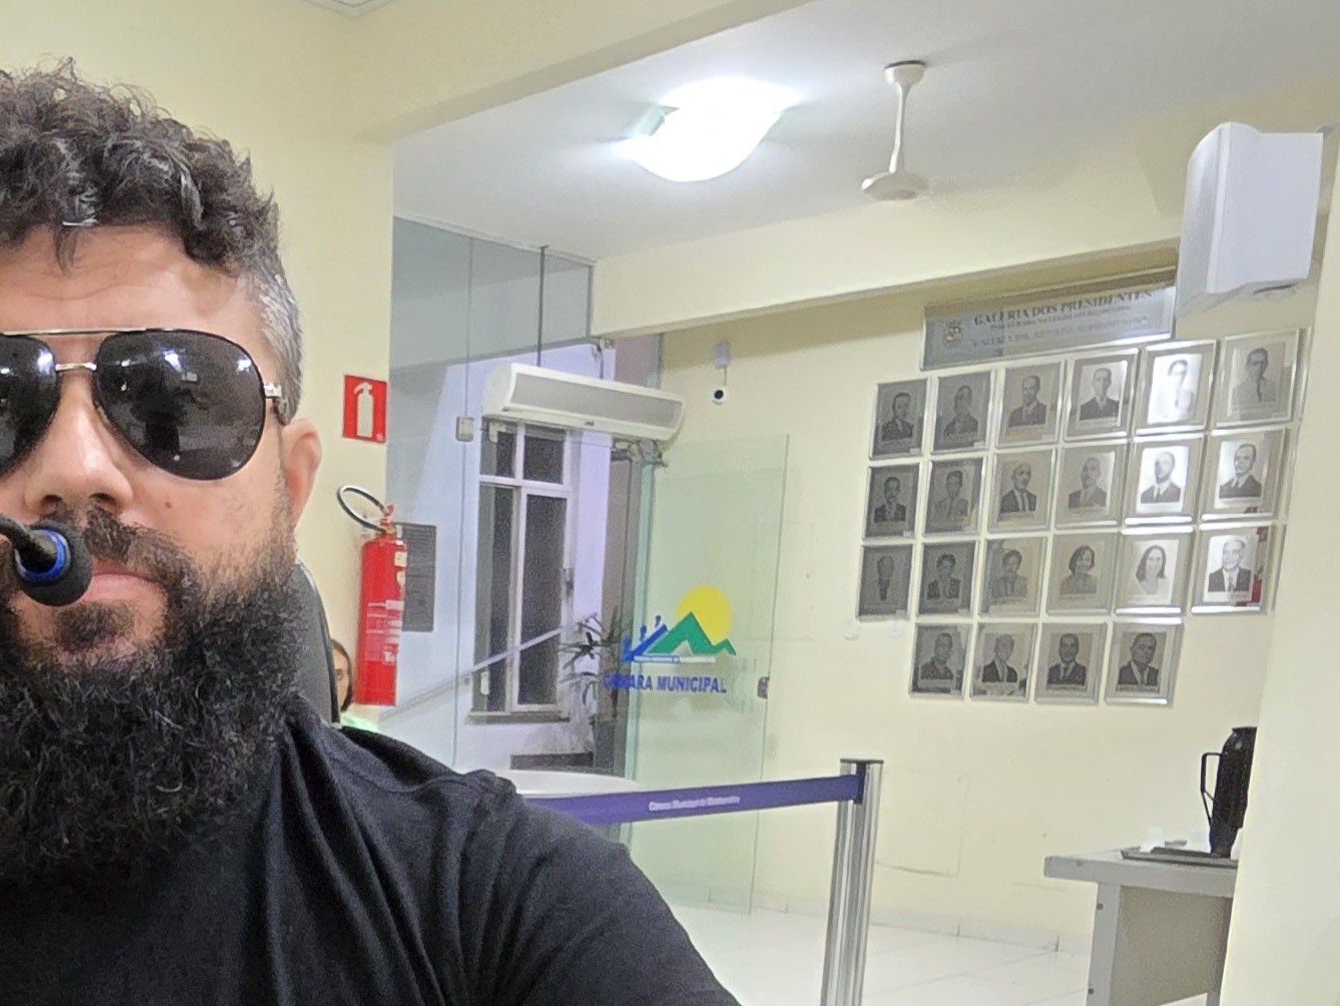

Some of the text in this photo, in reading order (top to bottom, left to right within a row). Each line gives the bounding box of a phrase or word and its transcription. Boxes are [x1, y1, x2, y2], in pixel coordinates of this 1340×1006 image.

[974, 309, 1030, 326] GALERIA
[1033, 304, 1058, 317] DOS
[657, 674, 727, 693] MUNICIPAL
